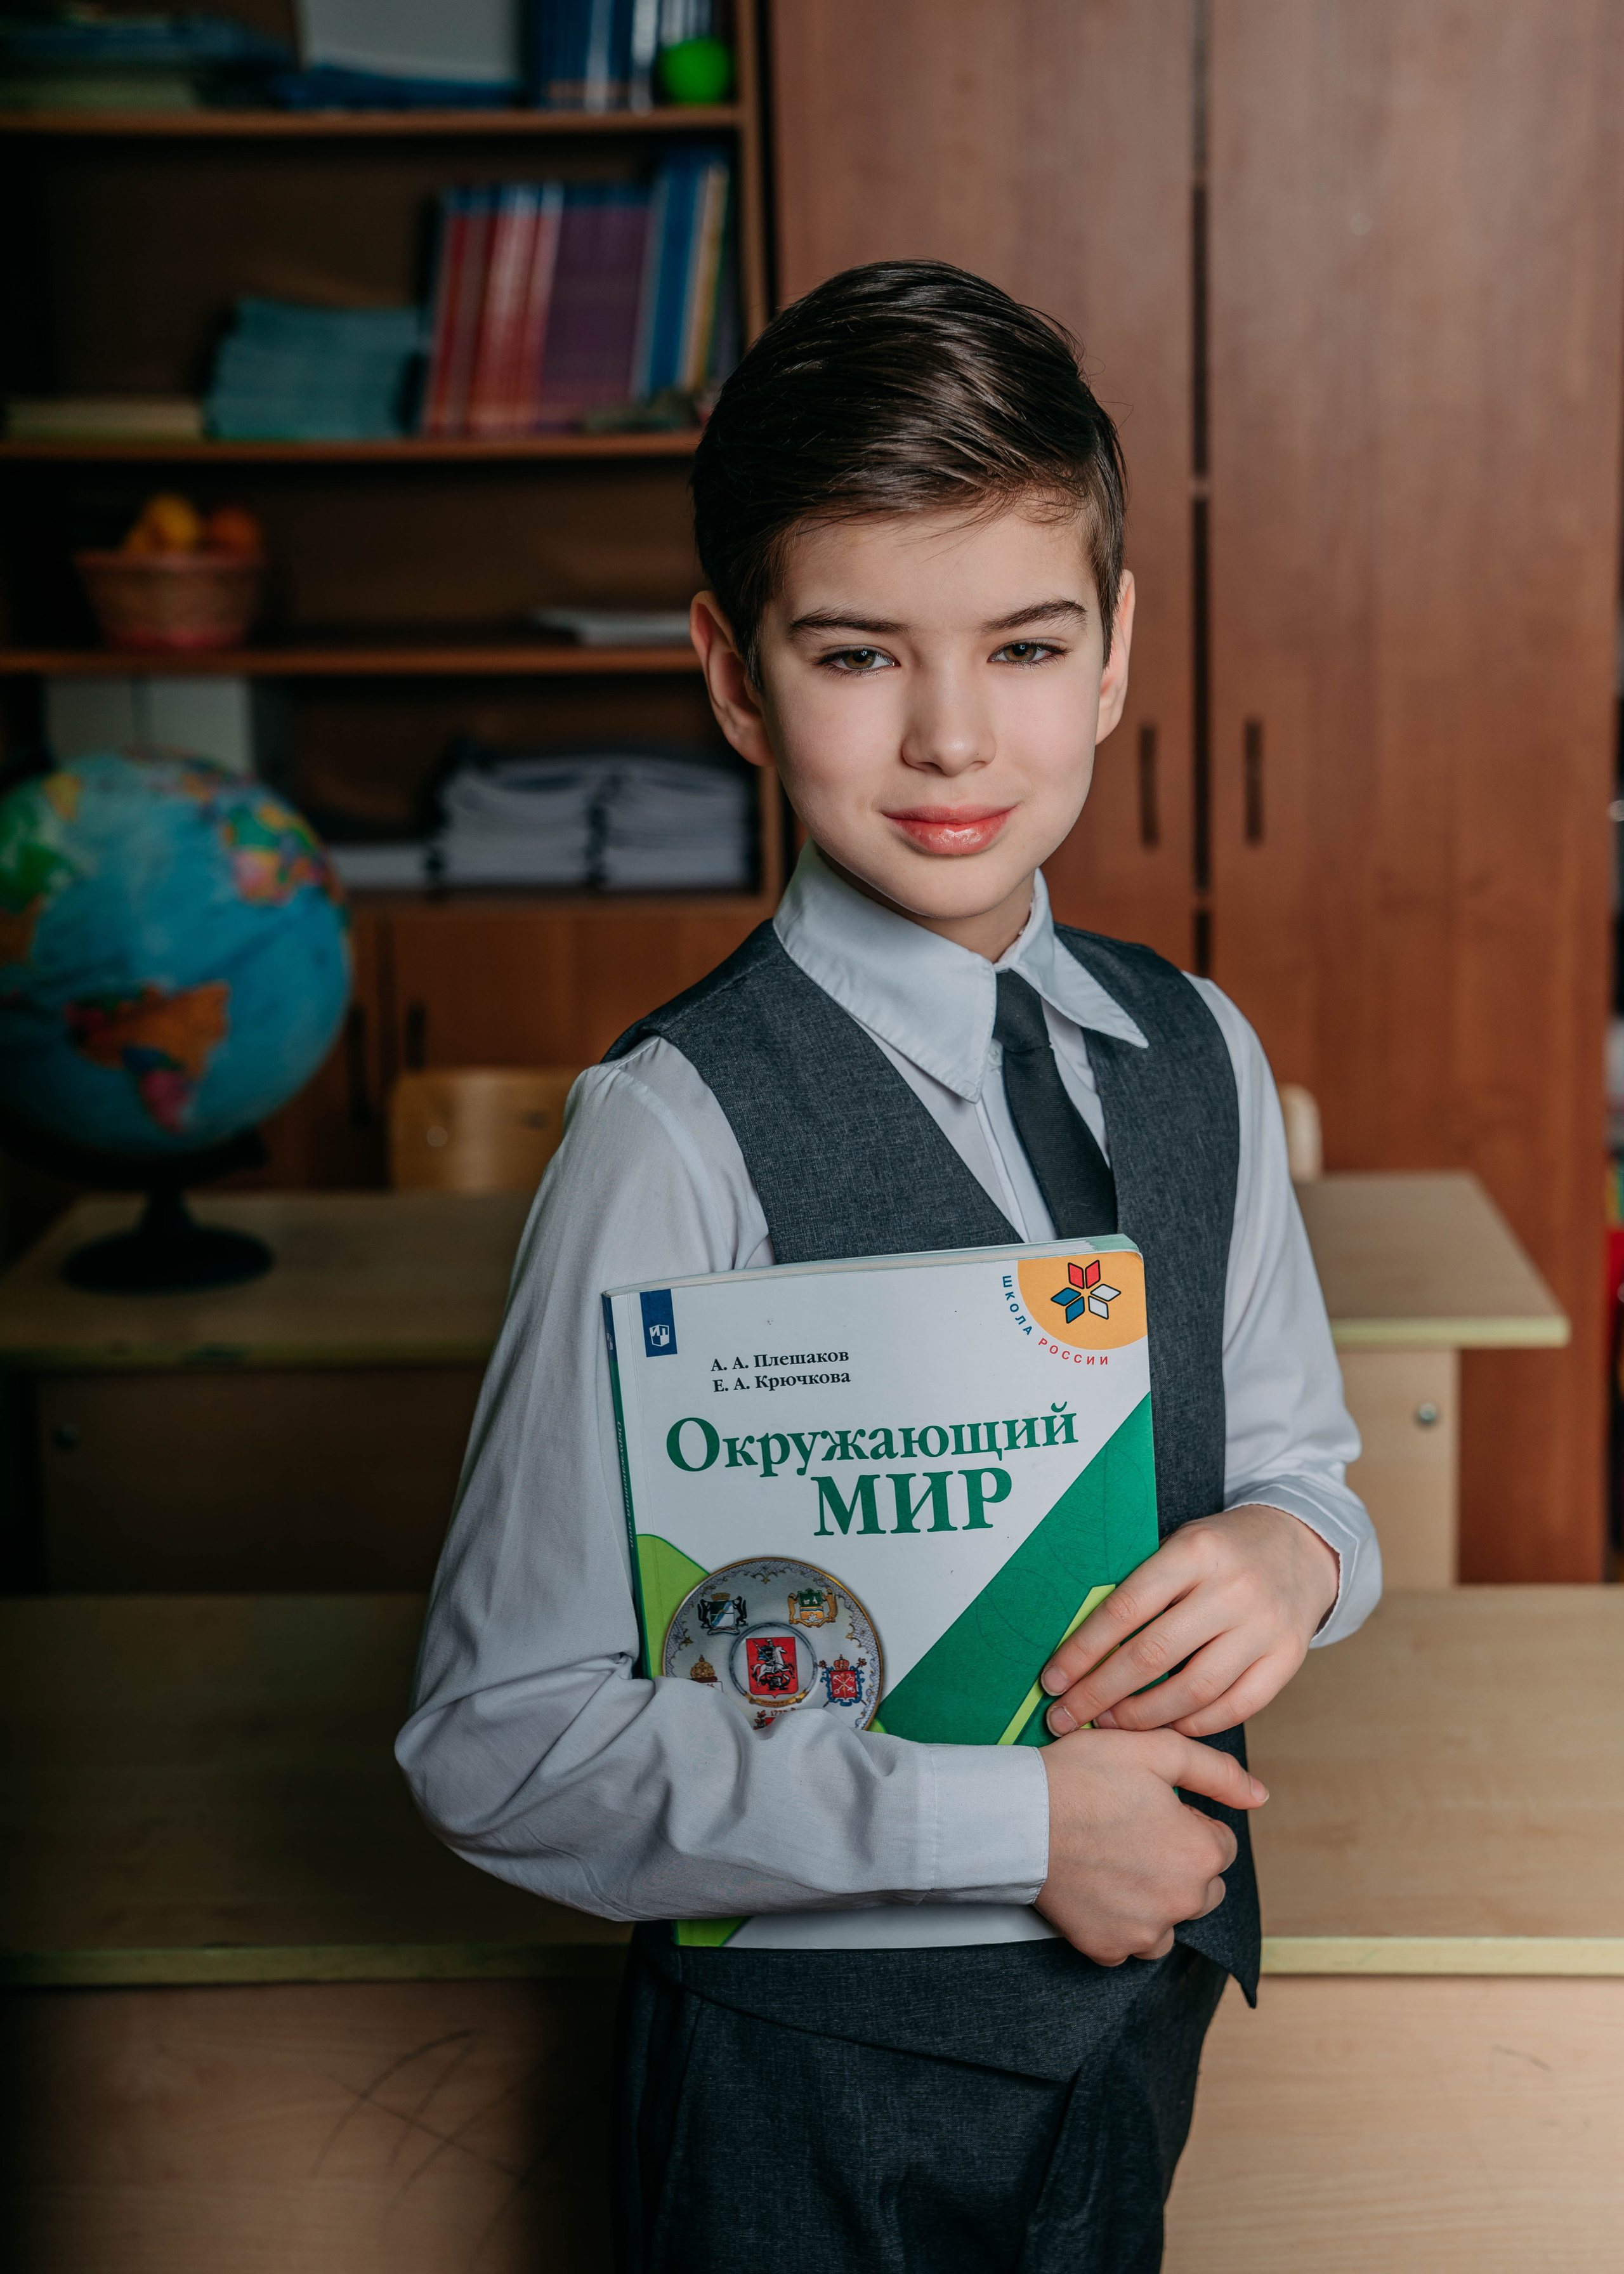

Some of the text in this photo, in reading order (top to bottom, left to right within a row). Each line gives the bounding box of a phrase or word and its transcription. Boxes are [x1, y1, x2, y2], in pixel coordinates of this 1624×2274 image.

[1002, 1275, 1108, 1365] ШКОЛА РОССИИ
[710, 1351, 849, 1372] А. А. Плешаков
[712, 1372, 851, 1393] Е. А. Крючкова
[667, 1401, 1078, 1478] Окружающий
[811, 1467, 1012, 1536] МИР
